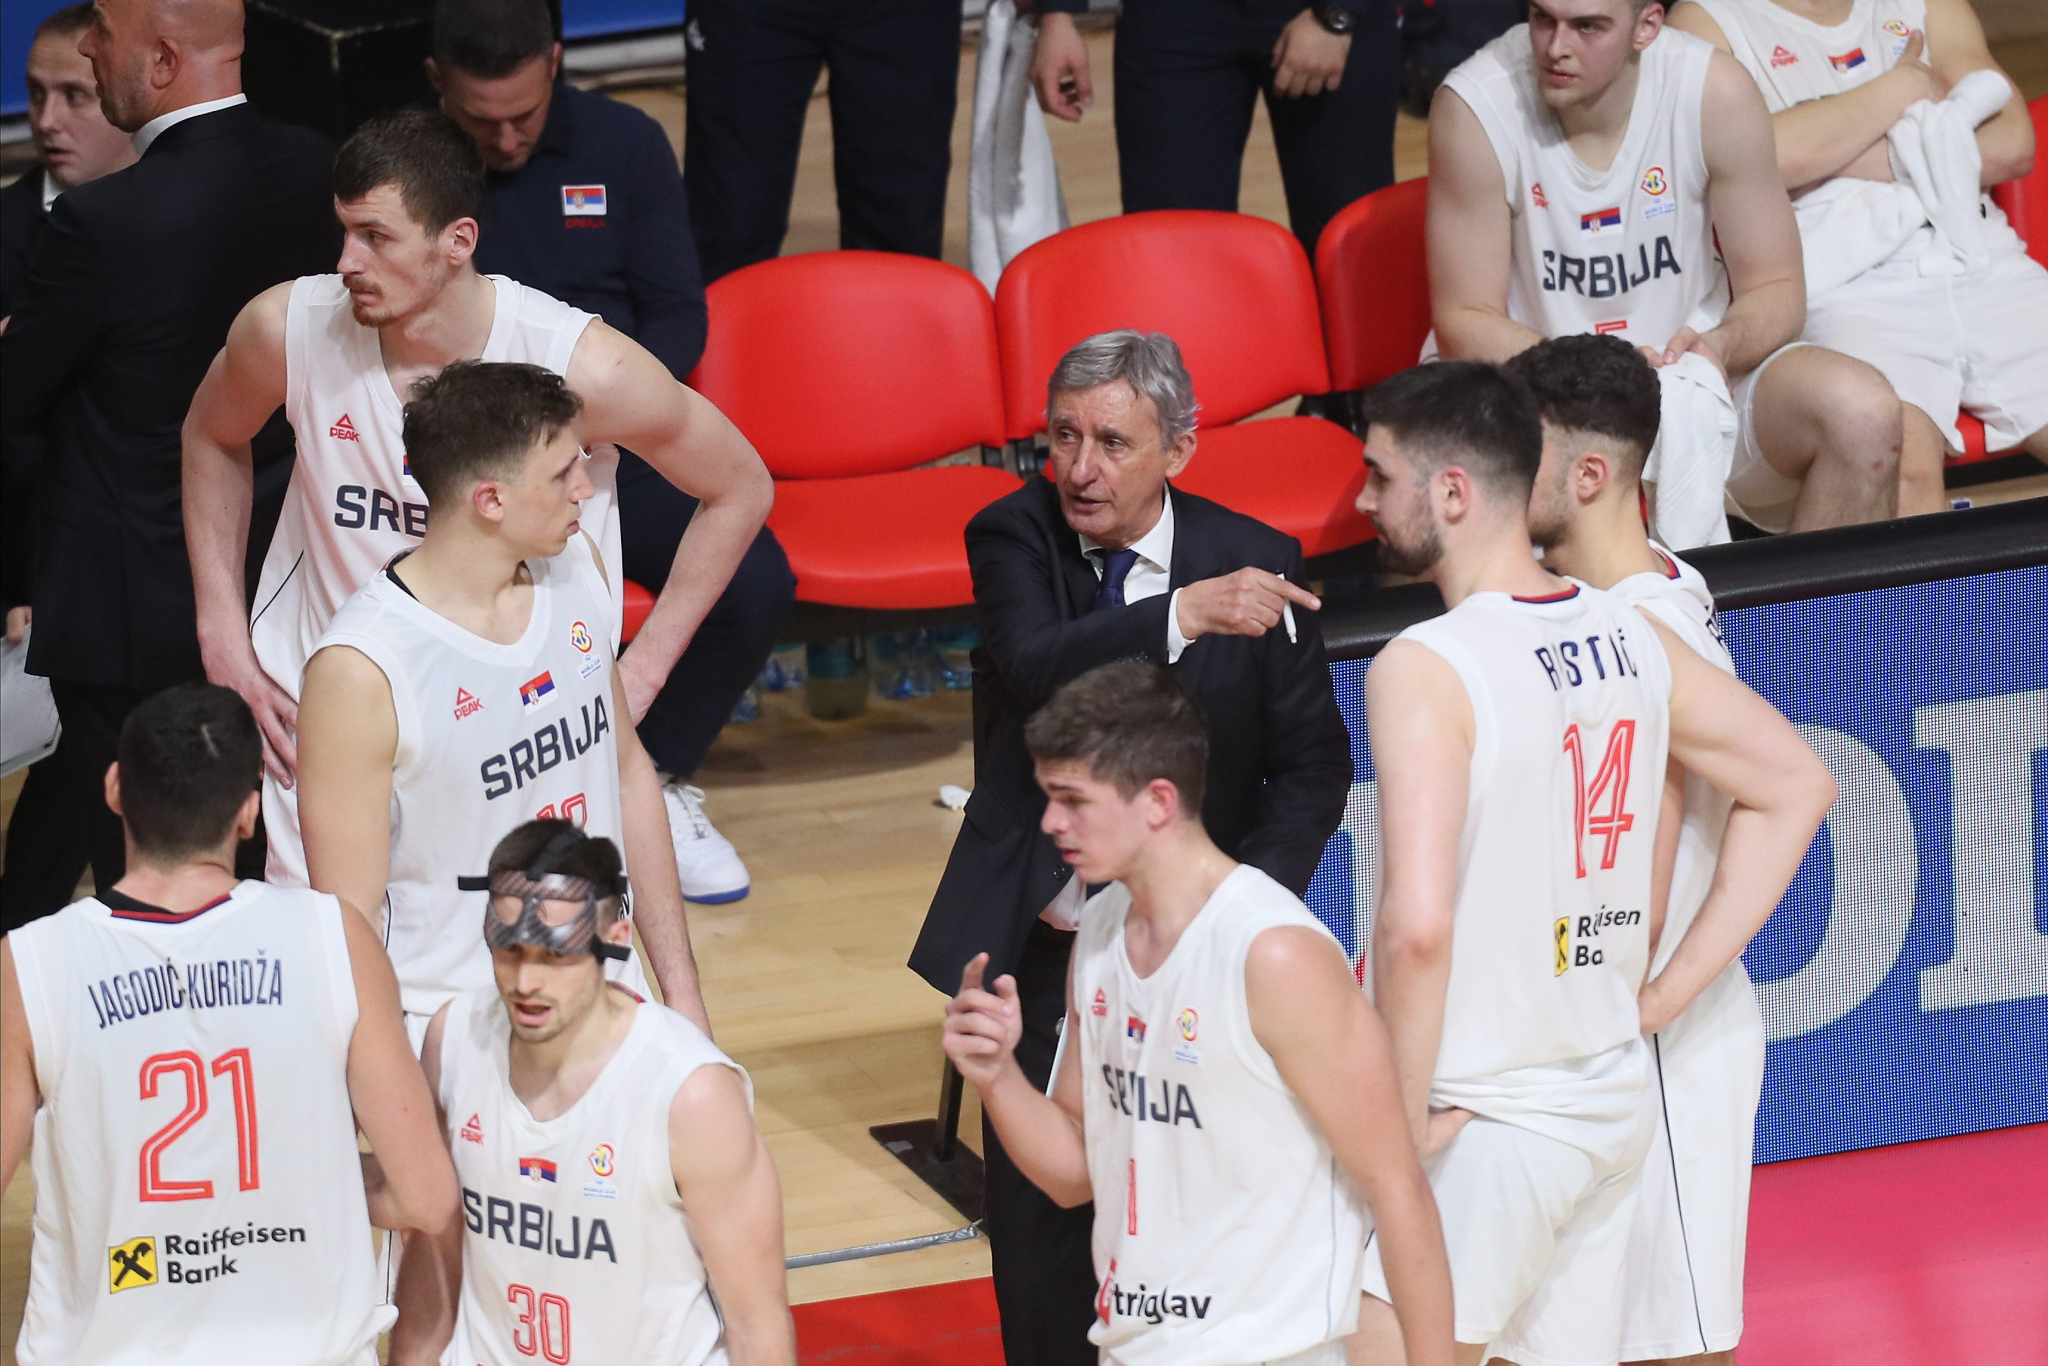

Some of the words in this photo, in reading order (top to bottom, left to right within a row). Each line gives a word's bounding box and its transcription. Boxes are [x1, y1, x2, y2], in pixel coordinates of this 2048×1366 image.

[1543, 235, 1682, 298] SRBIJA
[329, 427, 359, 443] PEAK
[334, 484, 430, 539] SRB
[454, 698, 484, 721] PEAK
[480, 693, 610, 801] SRBIJA
[1563, 719, 1636, 879] 14
[140, 1047, 260, 1202] 21
[1102, 1063, 1203, 1130] SRIJA
[164, 1222, 307, 1256] Raiffeisen
[462, 1187, 618, 1264] SRBIJA
[167, 1254, 239, 1284] Bank
[508, 1282, 572, 1366] 30
[1114, 1282, 1213, 1325] triglav
